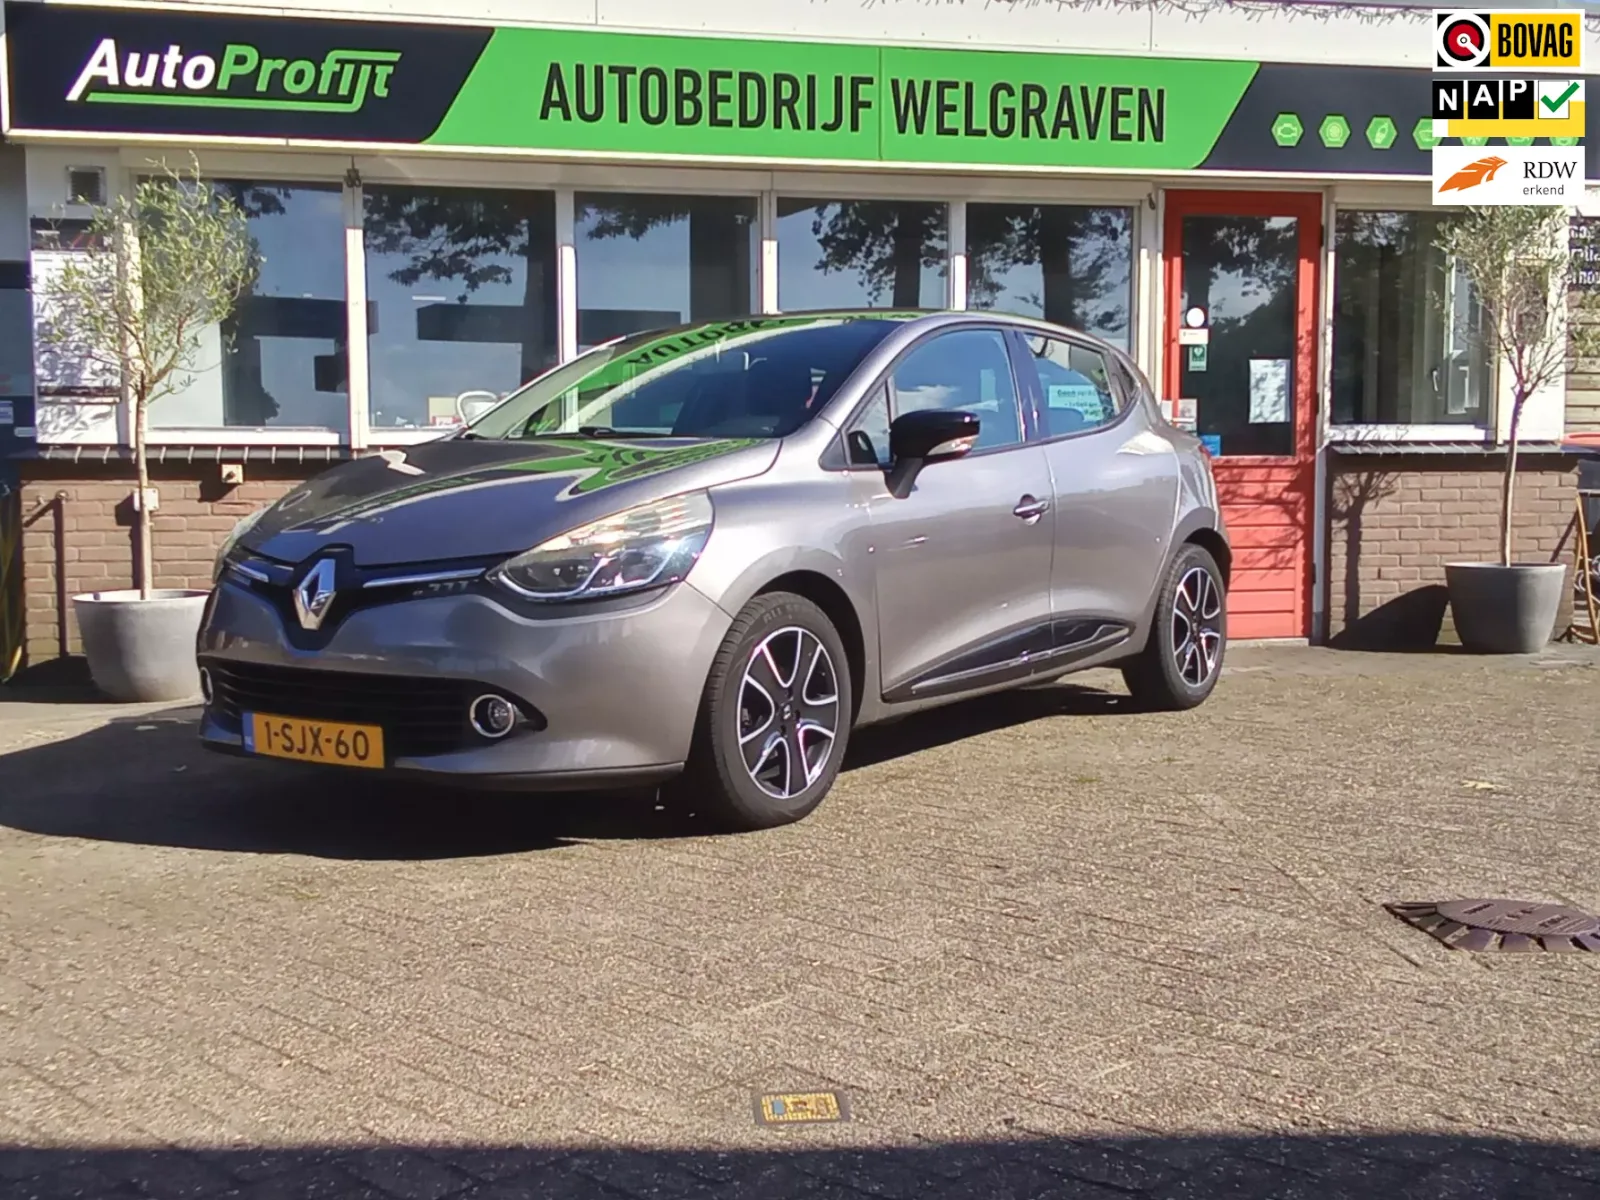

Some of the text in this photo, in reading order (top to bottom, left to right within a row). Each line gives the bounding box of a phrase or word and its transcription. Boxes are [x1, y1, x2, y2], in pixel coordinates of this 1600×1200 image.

[66, 38, 401, 112] AutoProfijt
[539, 62, 1165, 142] AUTOBEDRIJF WELGRAVEN
[264, 721, 369, 761] 1-SJX-60
